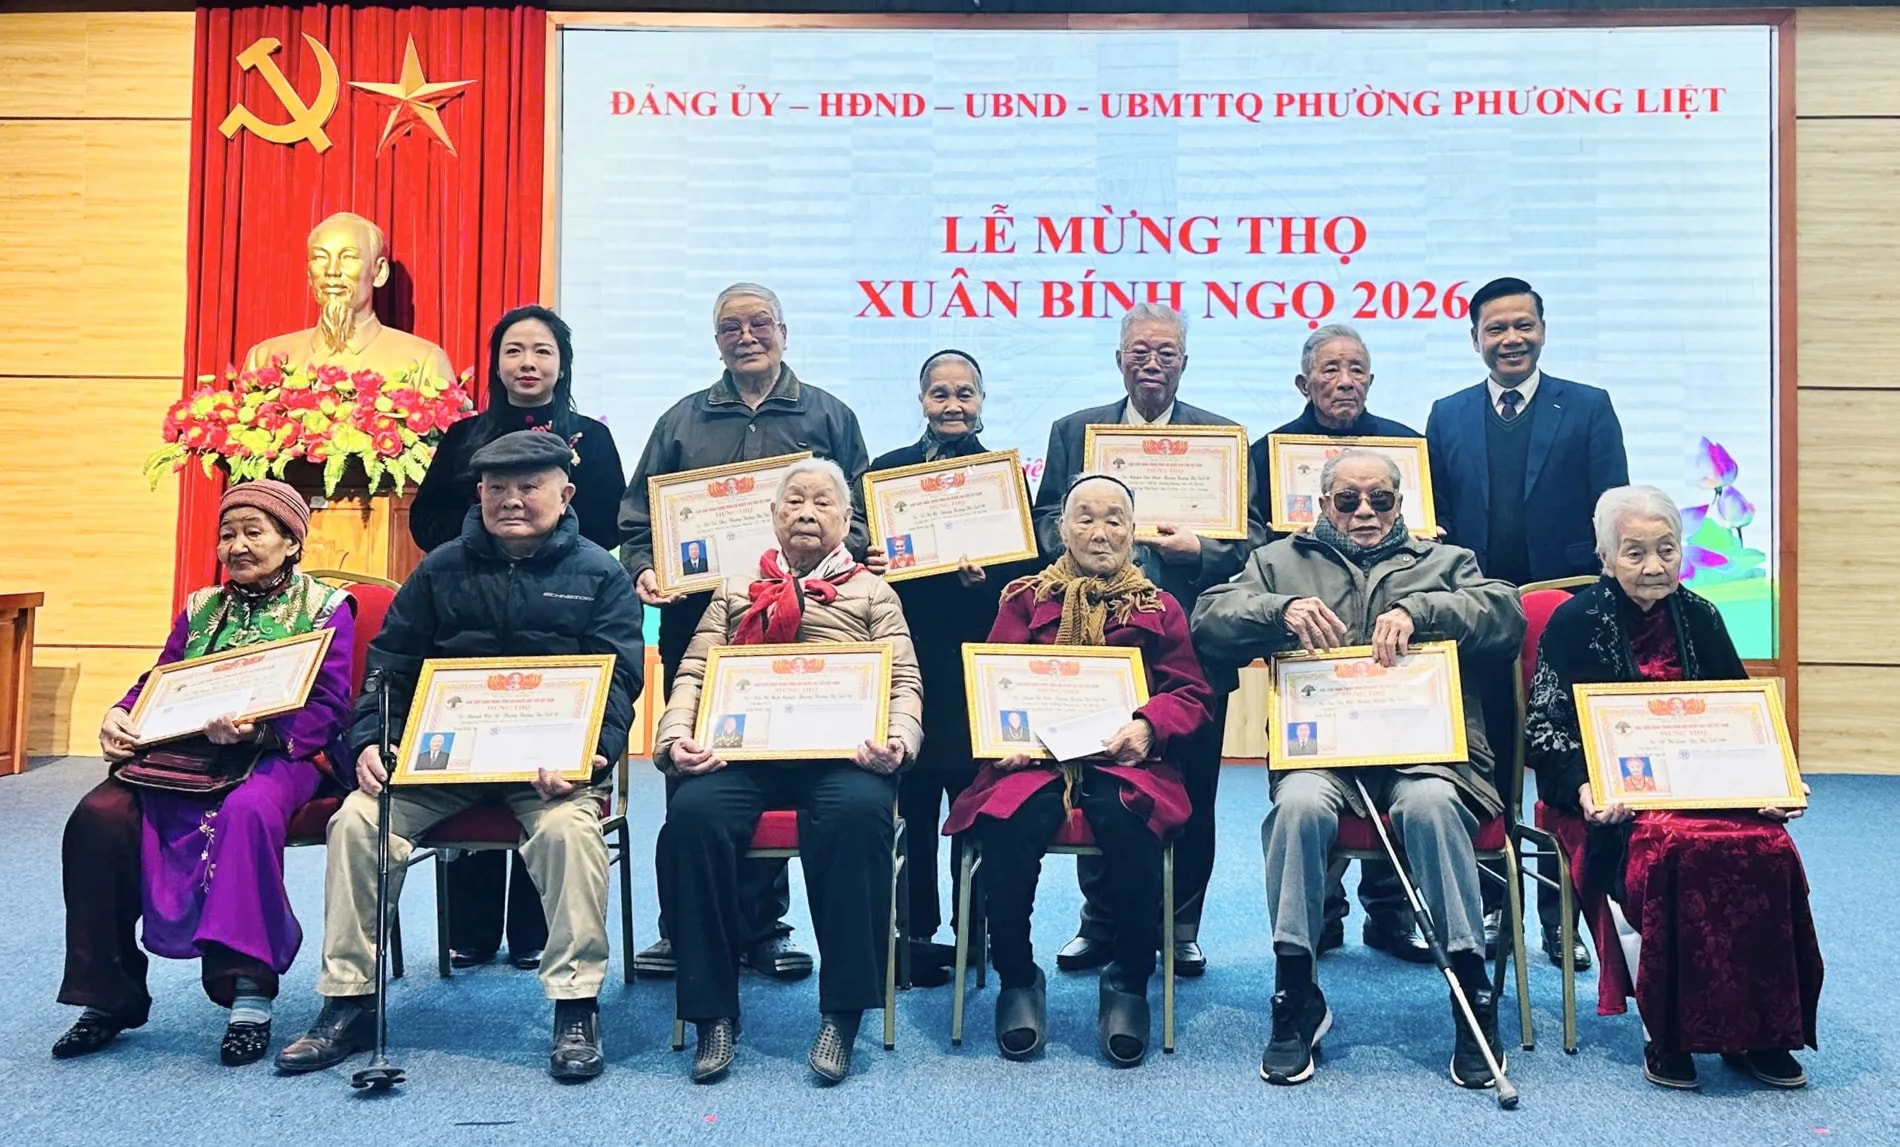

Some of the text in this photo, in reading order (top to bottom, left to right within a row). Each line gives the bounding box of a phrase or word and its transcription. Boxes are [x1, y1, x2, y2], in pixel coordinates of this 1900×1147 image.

[609, 83, 718, 117] ĐẢNG
[730, 83, 781, 118] ỦY
[819, 92, 927, 118] HĐND
[965, 93, 1068, 118] UBND
[1100, 92, 1263, 123] UBMTTQ
[1274, 83, 1441, 118] PHƯỜNG
[1453, 85, 1623, 116] PHƯƠNG
[1636, 83, 1727, 119] LIỆT
[942, 203, 1368, 265] LỄ MỪNG THỌ
[855, 267, 1470, 330] XUÂN BÍNH NGỌ 2026
